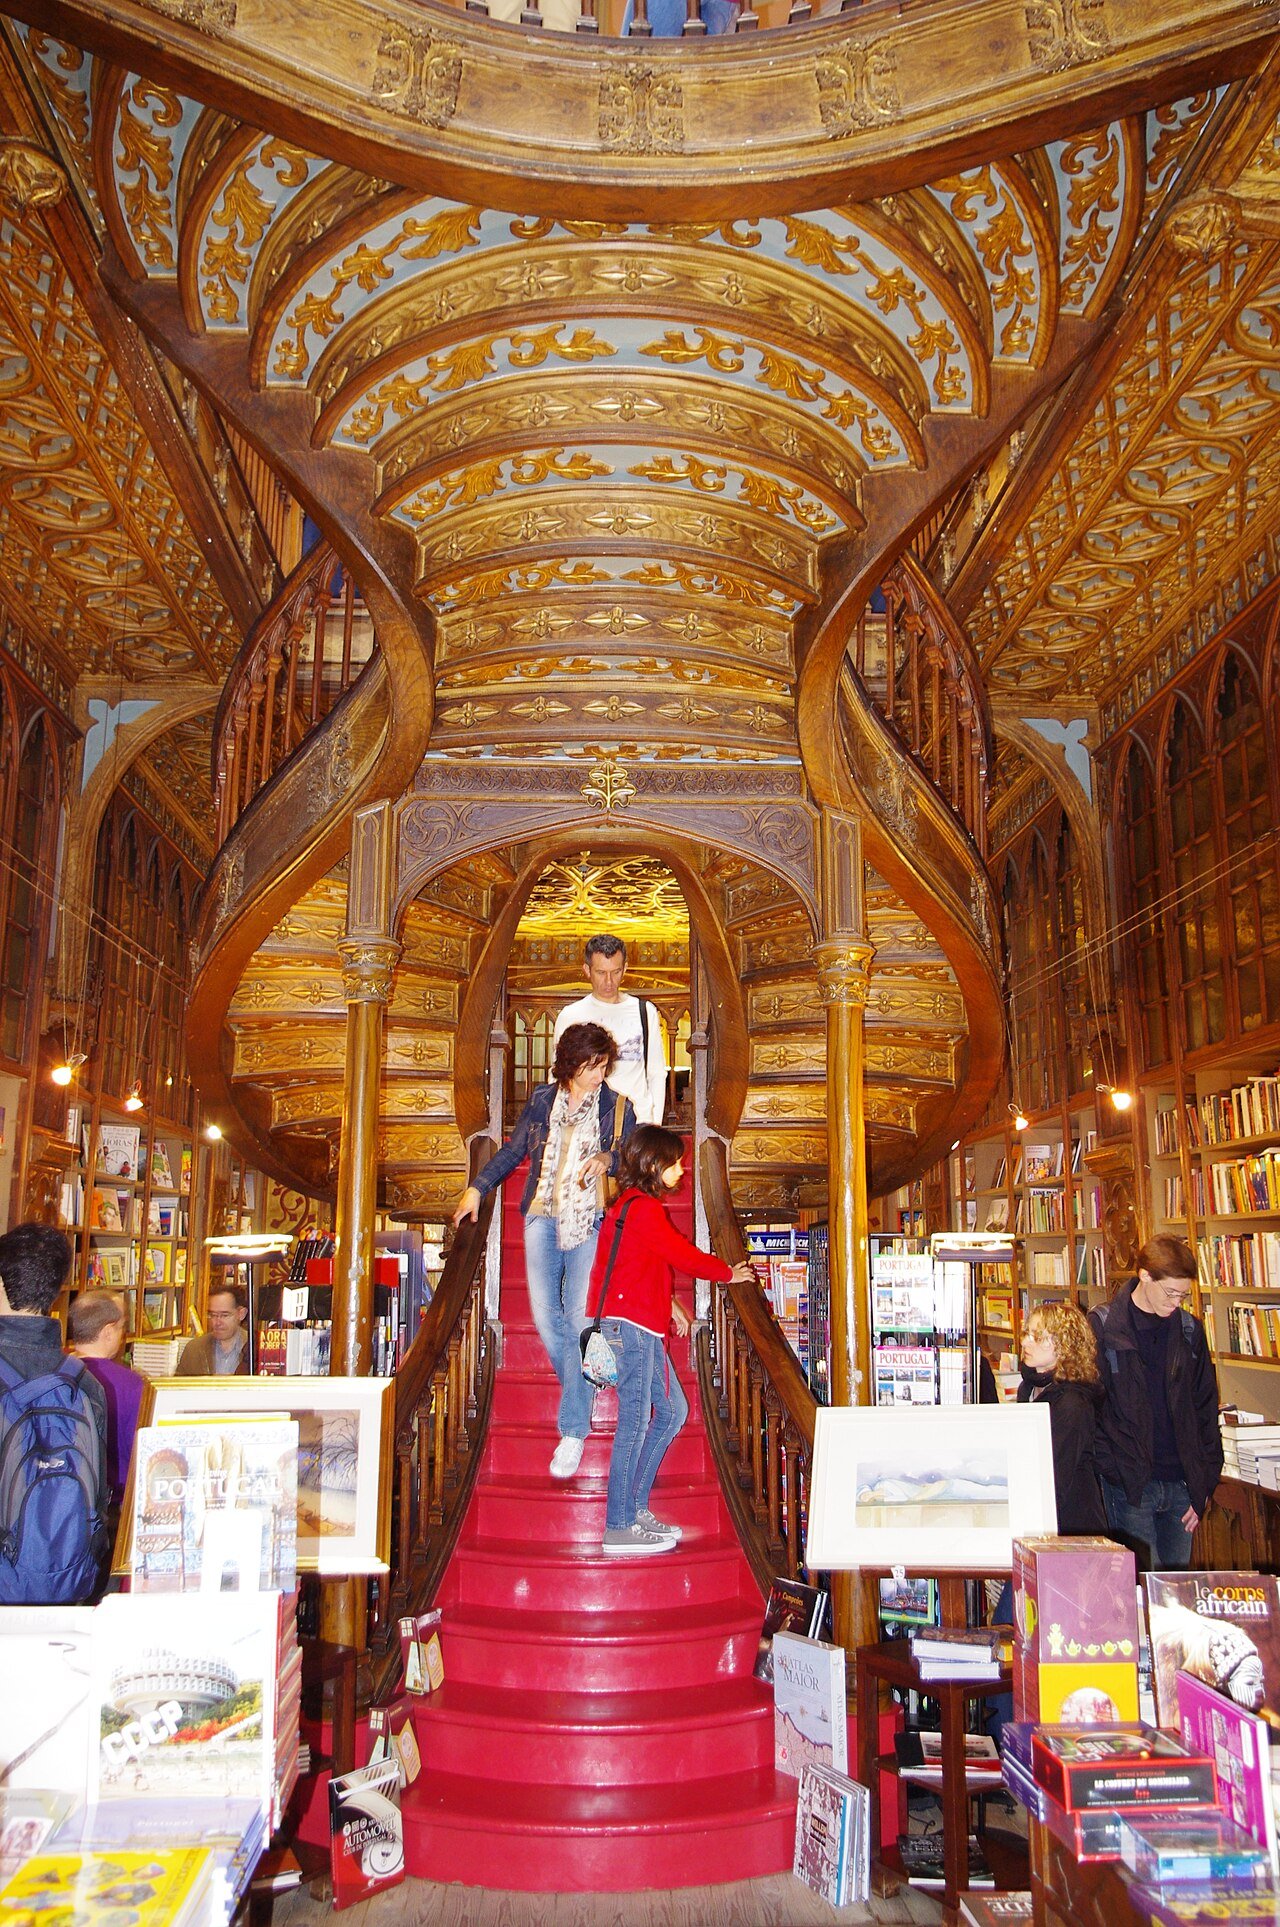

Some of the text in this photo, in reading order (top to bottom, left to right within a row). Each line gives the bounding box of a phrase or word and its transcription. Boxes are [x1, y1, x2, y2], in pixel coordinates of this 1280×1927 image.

[295, 1305, 304, 1317] 17
[879, 1353, 929, 1364] PORTUGAL
[154, 1477, 284, 1500] PORTUGAL
[1194, 1580, 1265, 1602] le corps
[1196, 1593, 1269, 1615] africain
[787, 1659, 814, 1675] ATLAS
[784, 1669, 820, 1692] MAIOR
[101, 1700, 184, 1765] CCCP
[1094, 1780, 1104, 1789] LE
[1136, 1778, 1148, 1787] DU
[1148, 1776, 1190, 1786] SOMMELIER
